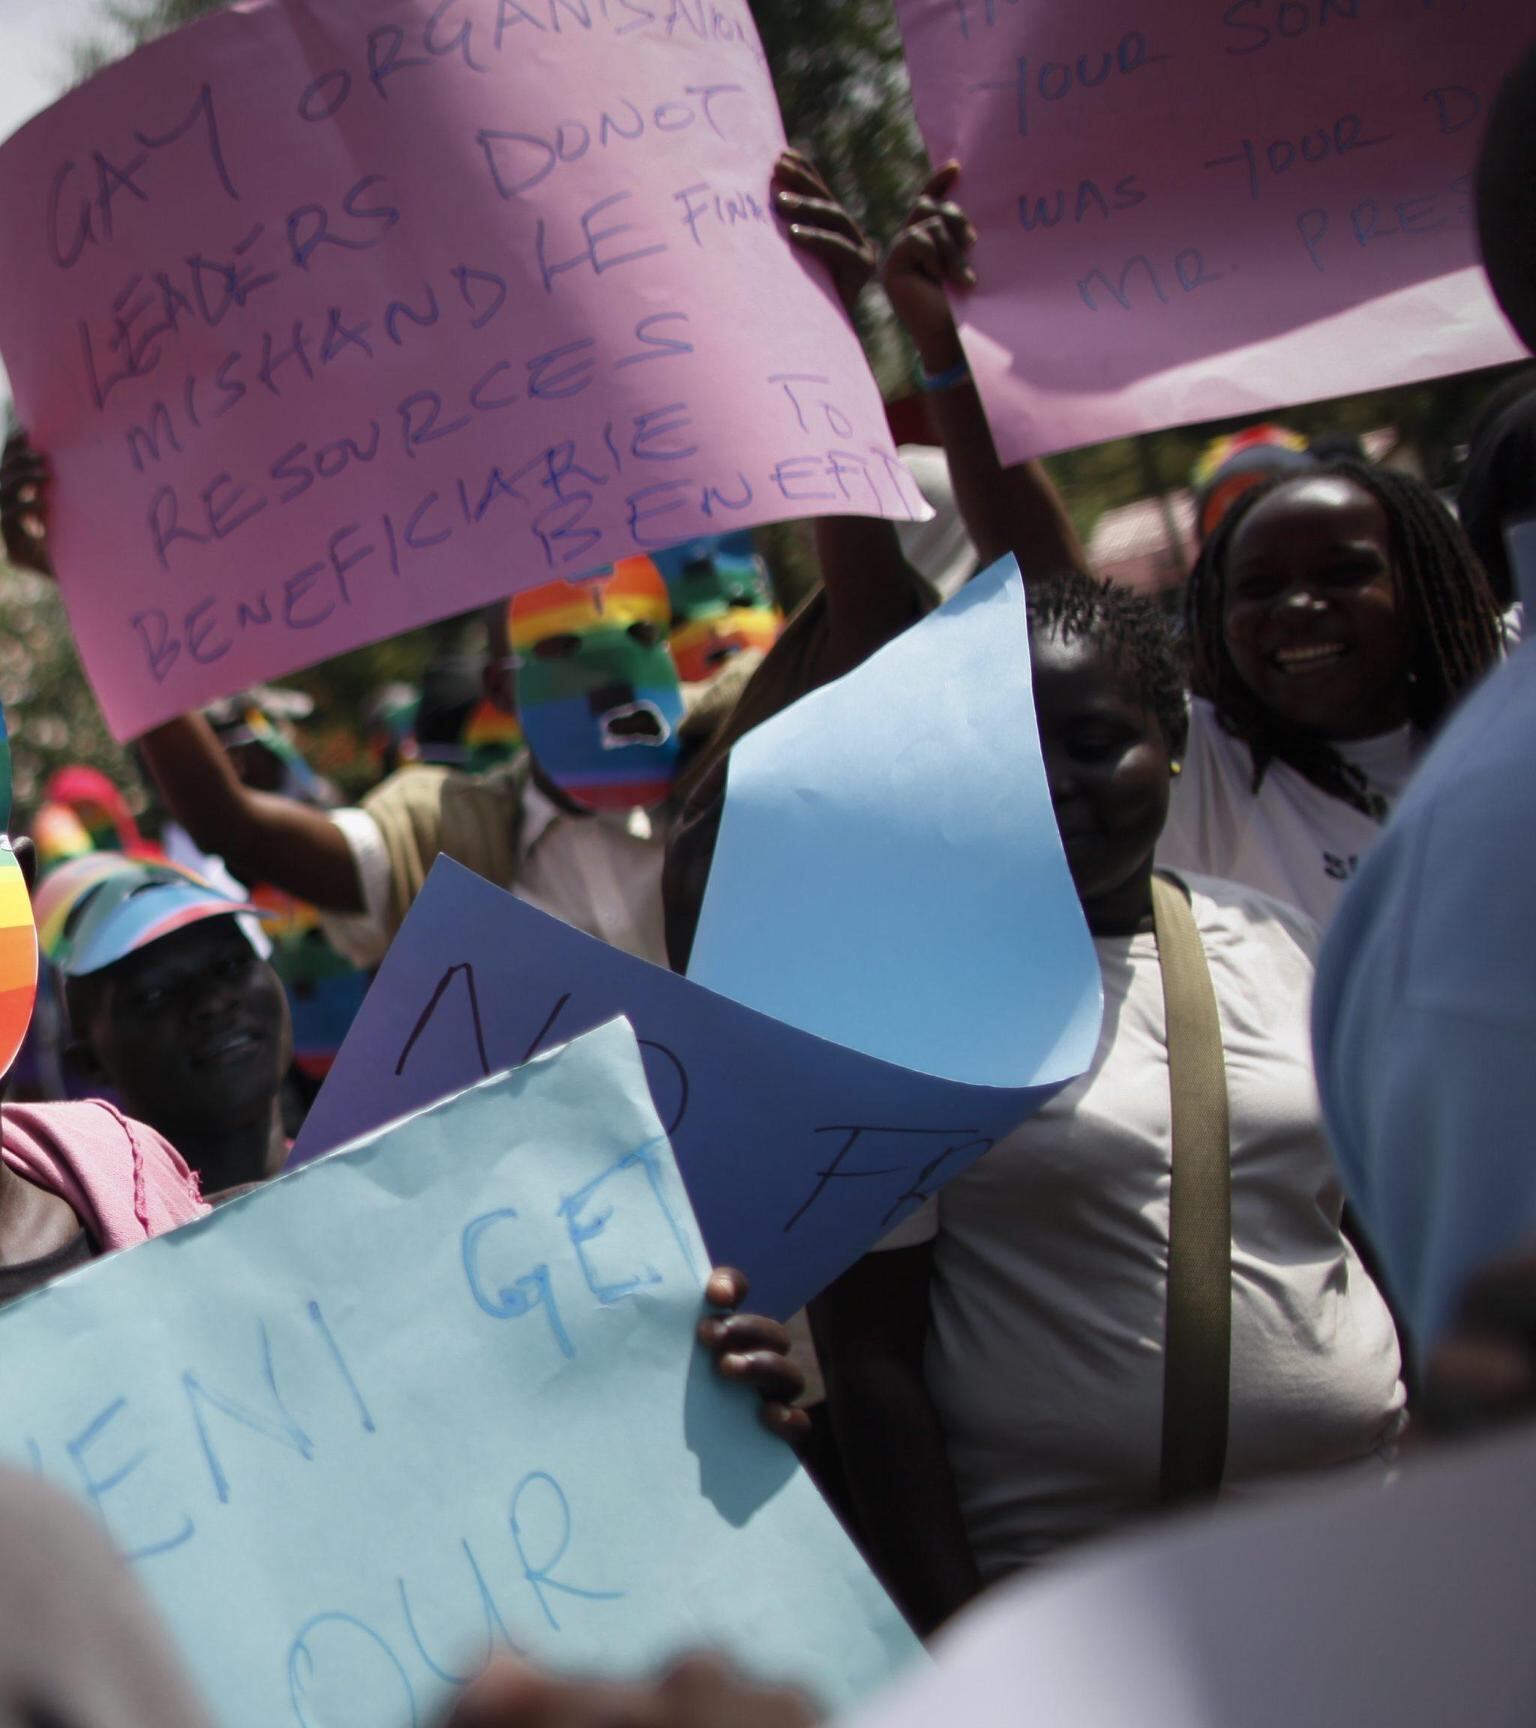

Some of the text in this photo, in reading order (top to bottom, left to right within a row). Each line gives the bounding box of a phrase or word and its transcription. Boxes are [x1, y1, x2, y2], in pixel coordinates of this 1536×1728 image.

[47, 83, 241, 269] GAY
[1018, 174, 1147, 232] WAS
[1204, 113, 1393, 201] YOUR
[81, 175, 400, 409] LEADERS
[127, 192, 665, 474] MISHANDLE
[132, 373, 855, 684] BENEFICIARIE TO
[147, 313, 695, 571] RESOURCES
[534, 446, 916, 567] BENEFIT
